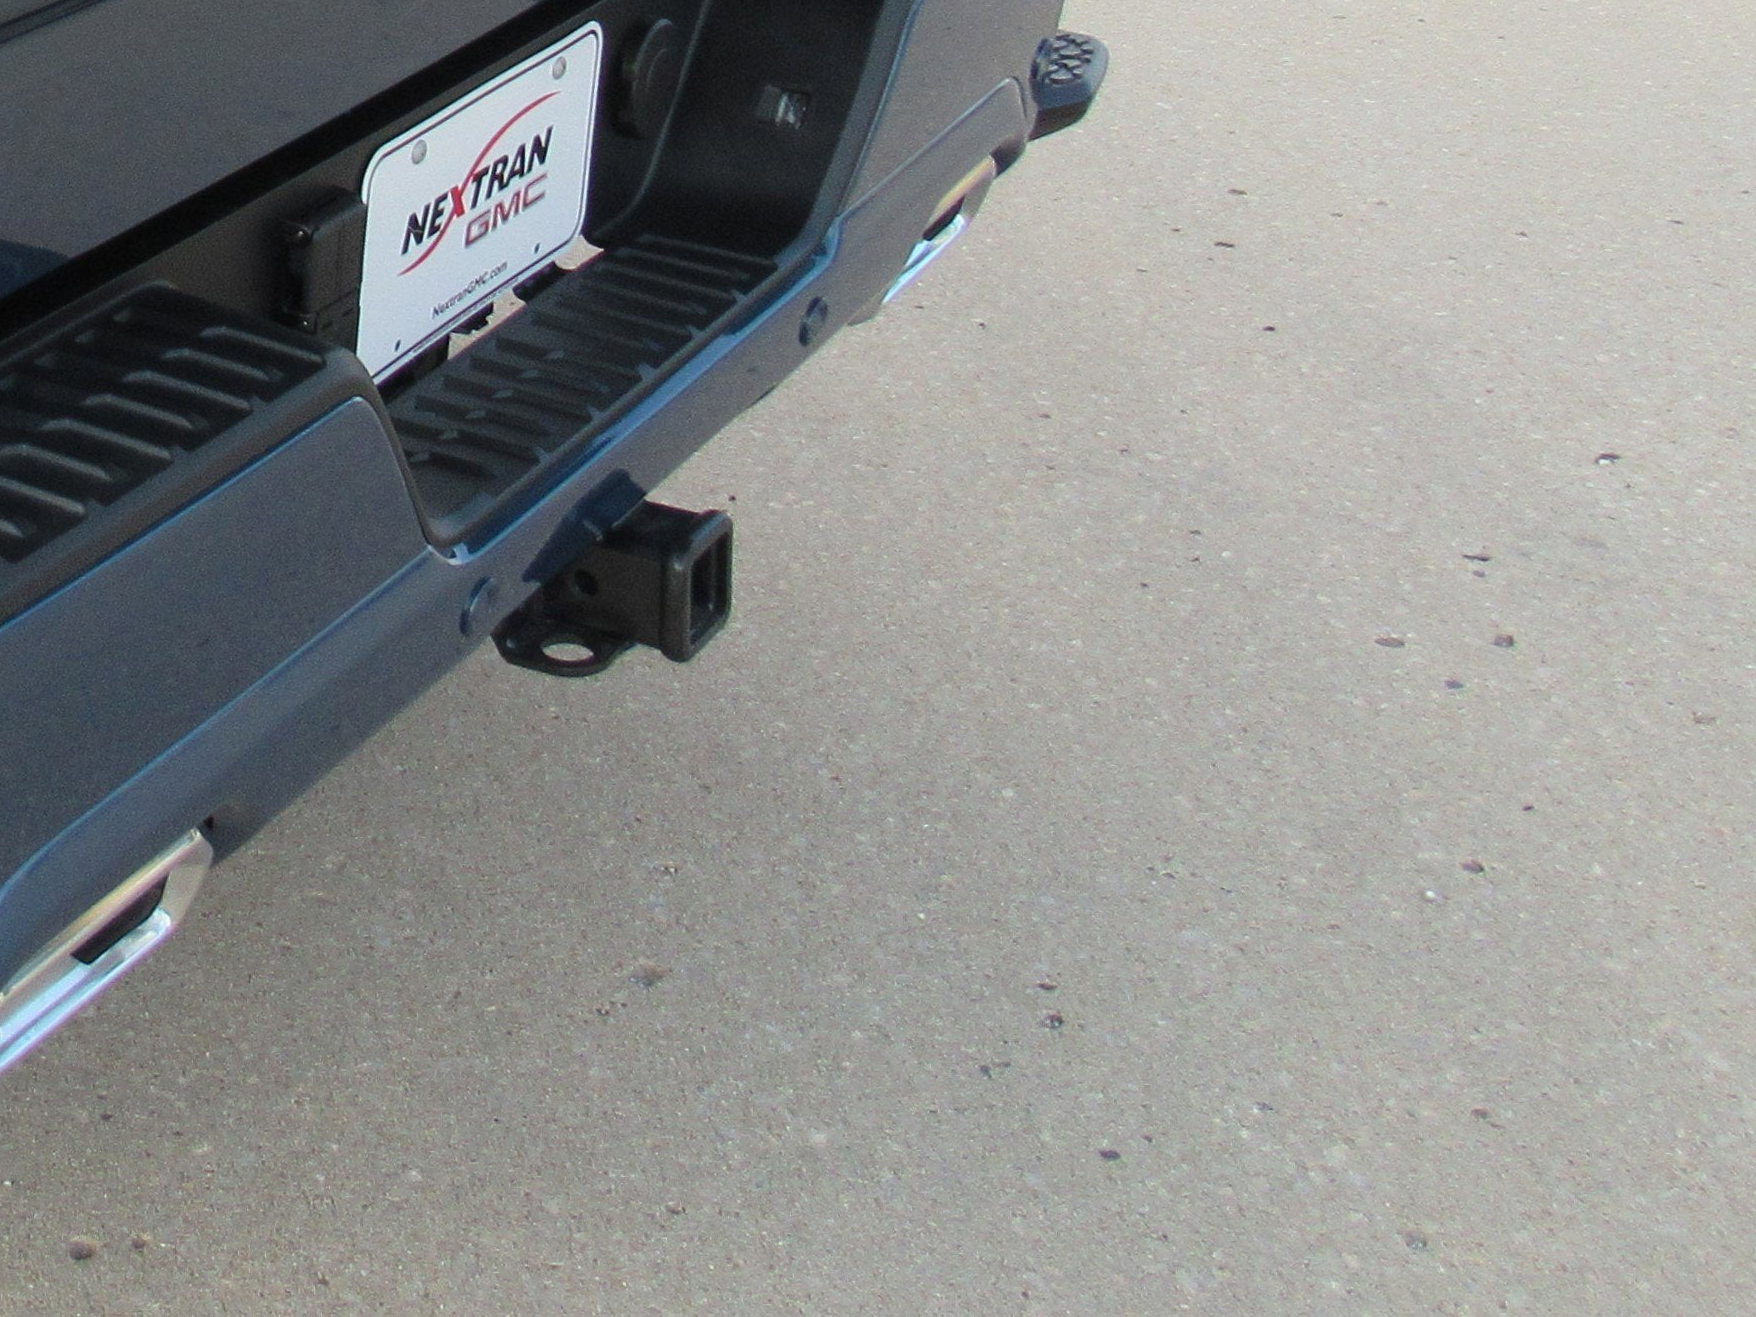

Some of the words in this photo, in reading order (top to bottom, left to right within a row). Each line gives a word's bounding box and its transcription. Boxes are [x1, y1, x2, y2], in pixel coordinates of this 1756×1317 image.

[401, 125, 554, 256] NEXTRAN
[464, 173, 548, 249] GMC
[431, 261, 508, 319] NextranGMC.com
